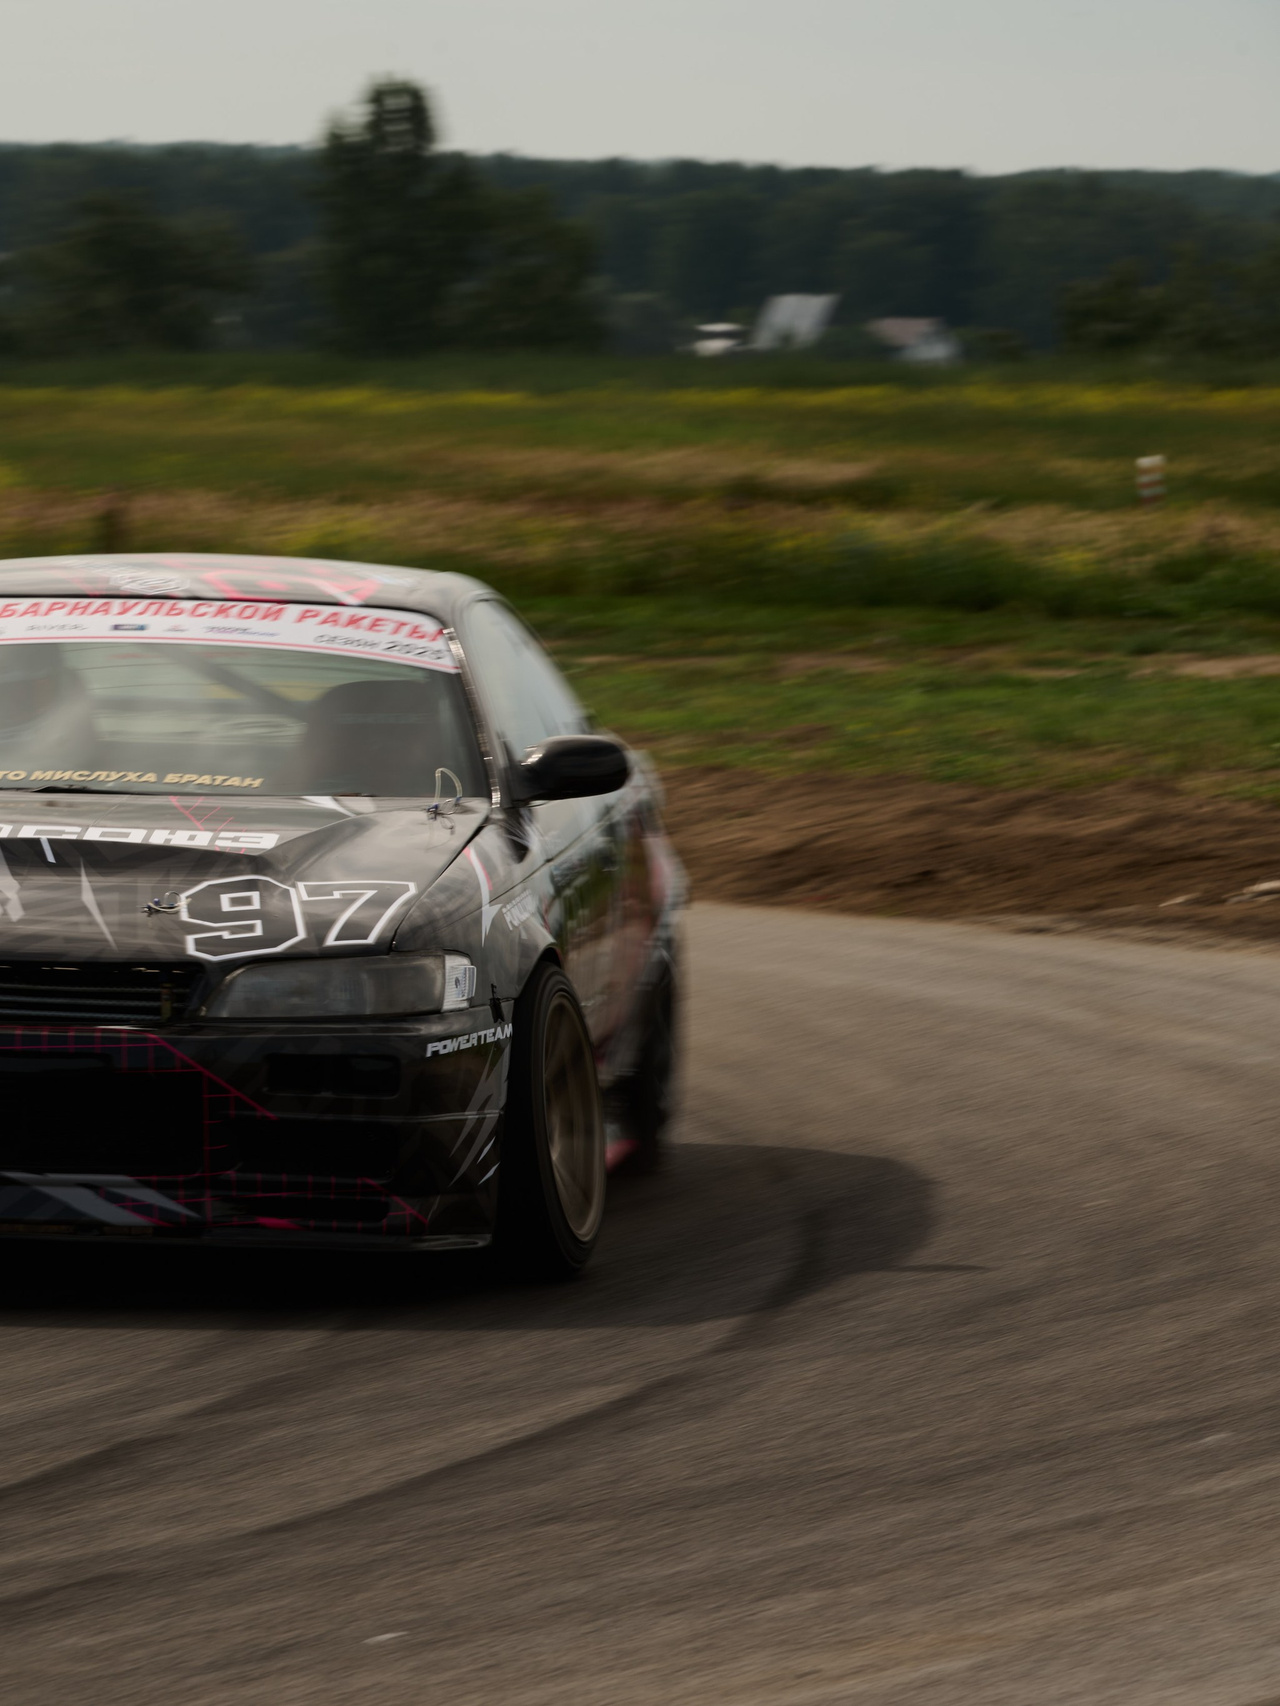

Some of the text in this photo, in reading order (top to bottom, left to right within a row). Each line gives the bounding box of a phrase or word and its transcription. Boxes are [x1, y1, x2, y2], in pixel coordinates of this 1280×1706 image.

[294, 608, 446, 642] РАКЕТЫ
[29, 770, 158, 783] МИСЛУХА
[162, 773, 265, 789] БРАТАН
[17, 824, 281, 850] СОЮЗ
[180, 875, 418, 962] 97
